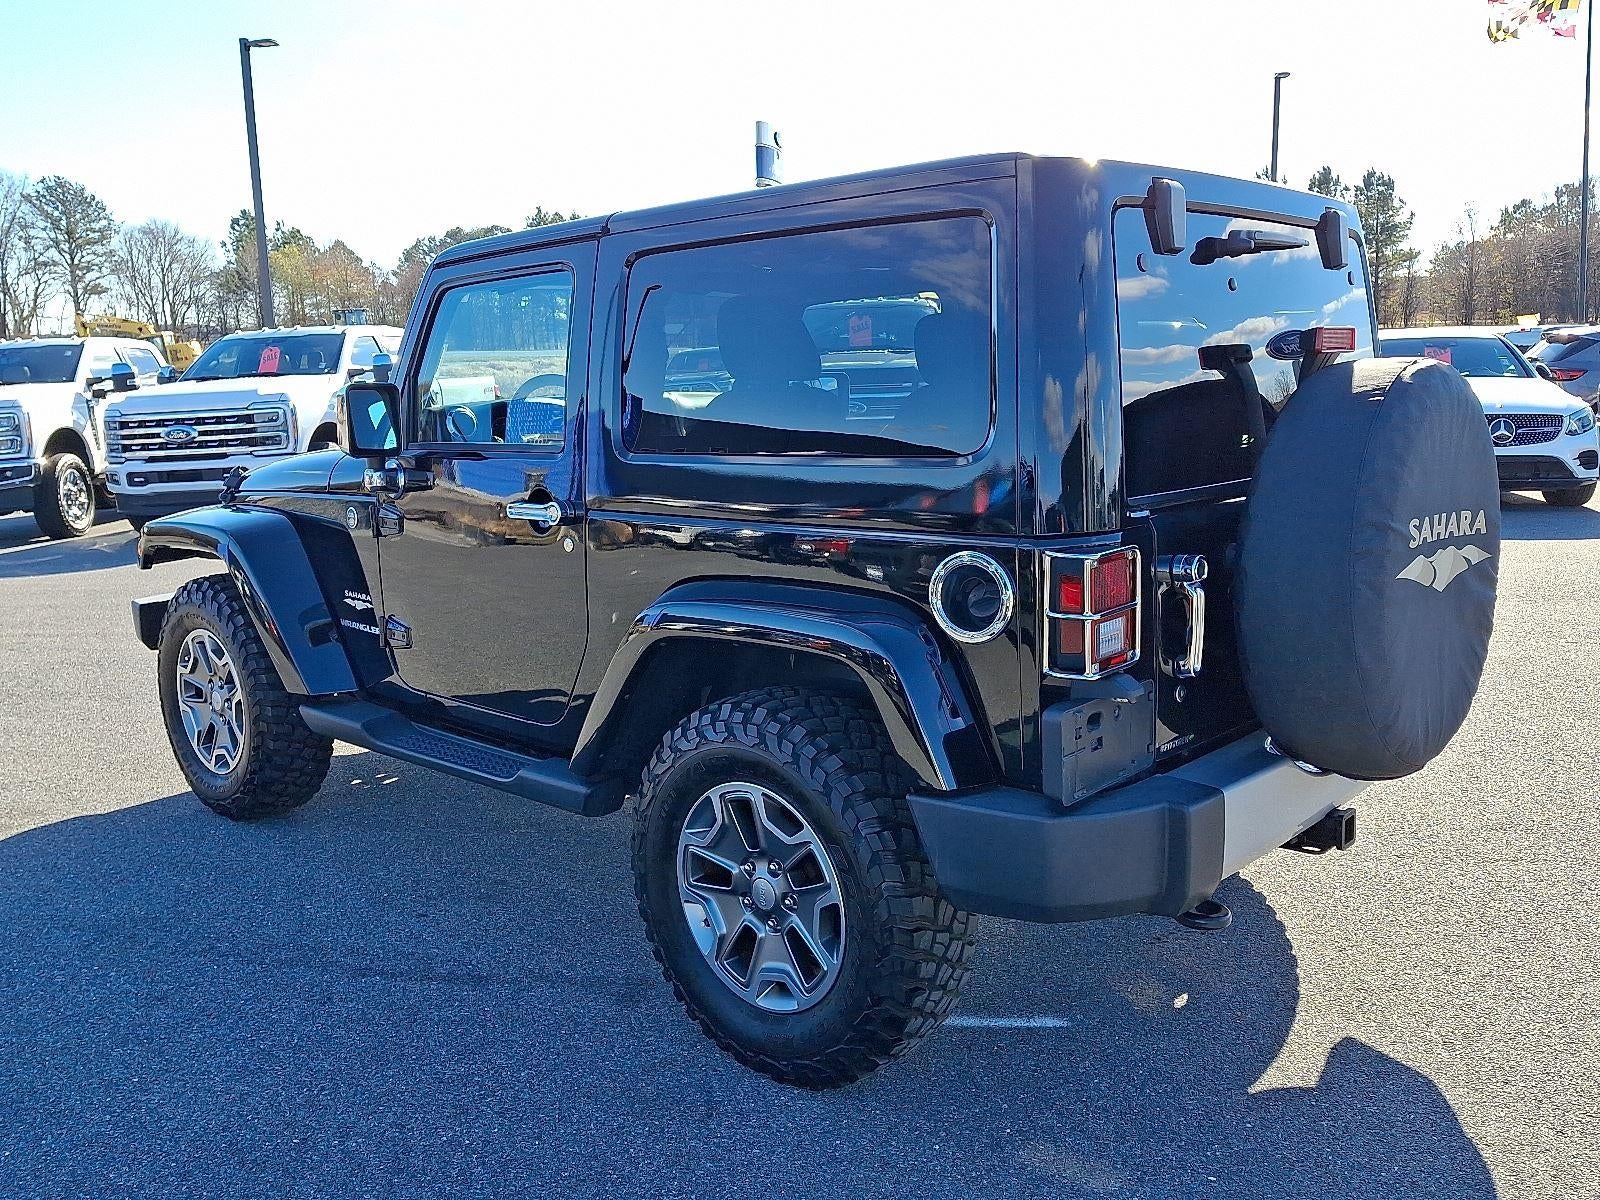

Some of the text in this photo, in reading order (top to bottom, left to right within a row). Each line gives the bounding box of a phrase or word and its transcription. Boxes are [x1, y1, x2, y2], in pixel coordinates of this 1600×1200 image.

[262, 351, 279, 364] SALE
[1408, 509, 1487, 549] SAHARA
[344, 589, 372, 602] SAHARA
